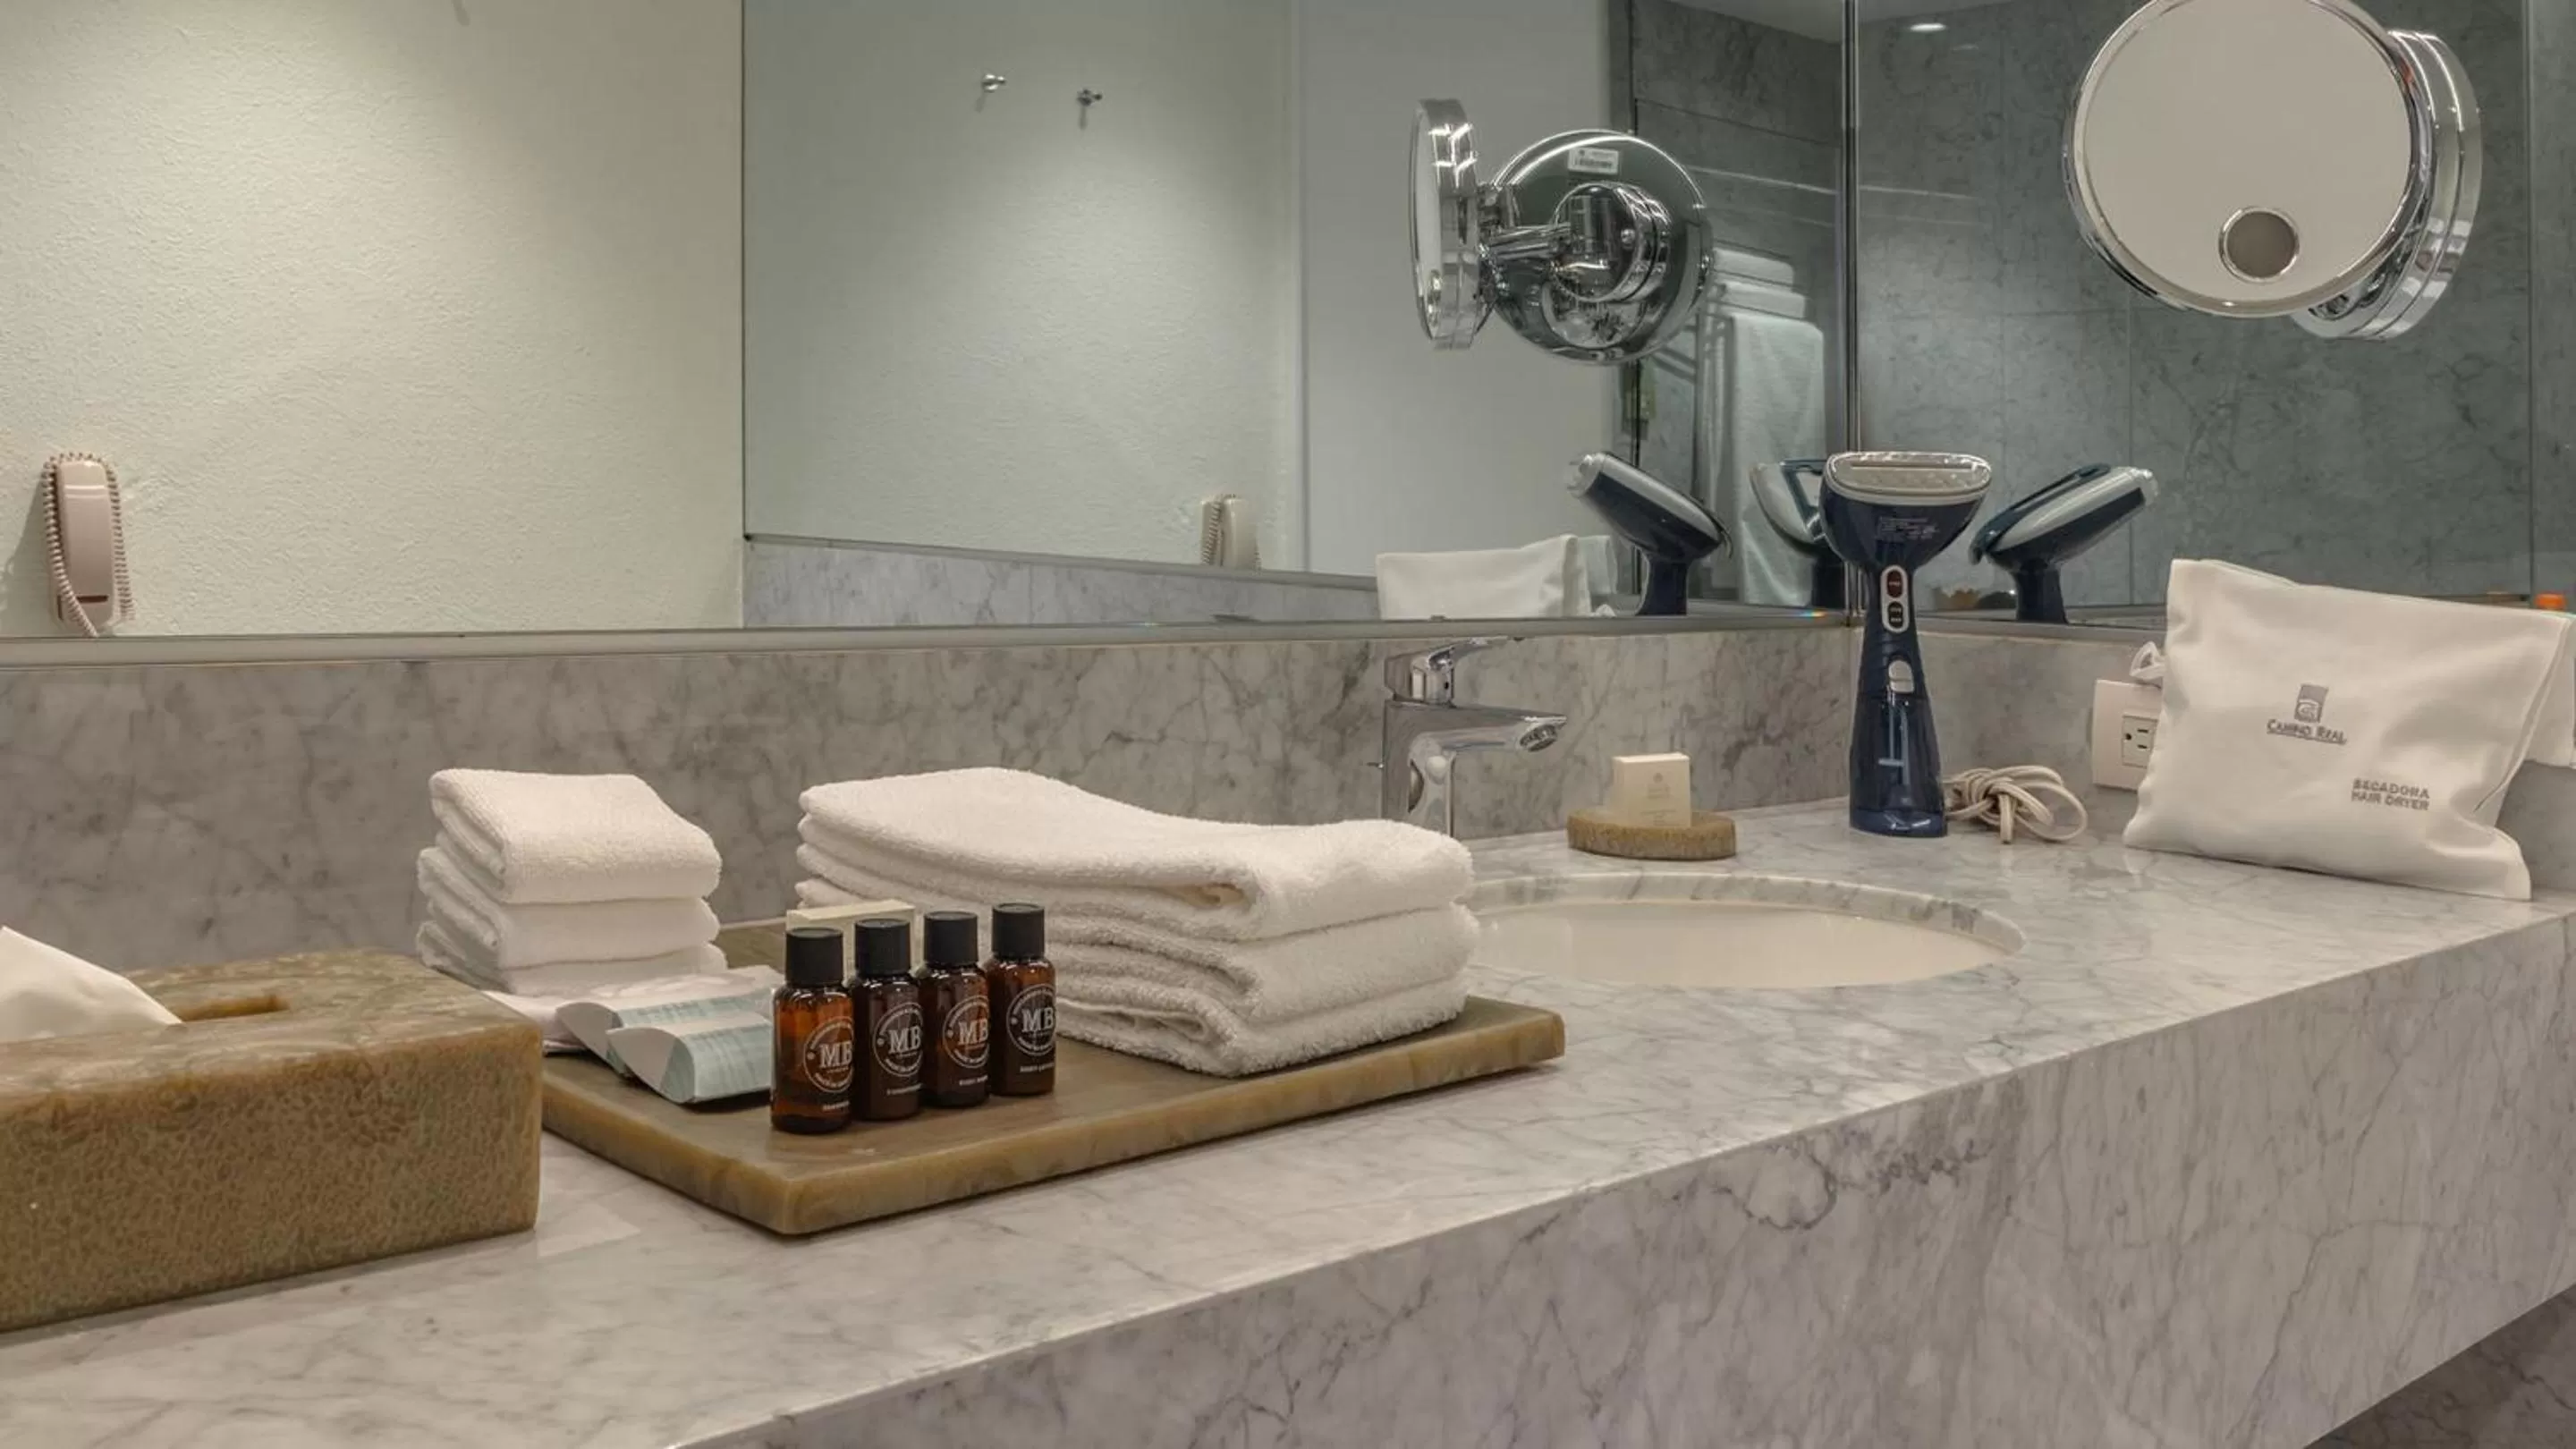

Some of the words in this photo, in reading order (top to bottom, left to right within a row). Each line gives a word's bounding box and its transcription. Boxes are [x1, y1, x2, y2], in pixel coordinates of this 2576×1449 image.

[2317, 725, 2346, 743] REAL
[2351, 791, 2381, 804] HAIR
[2385, 794, 2429, 810] DRYER
[958, 1018, 988, 1045] MB
[1022, 1007, 1055, 1032] MB
[888, 1026, 921, 1054] MB
[819, 1041, 852, 1069] MB
